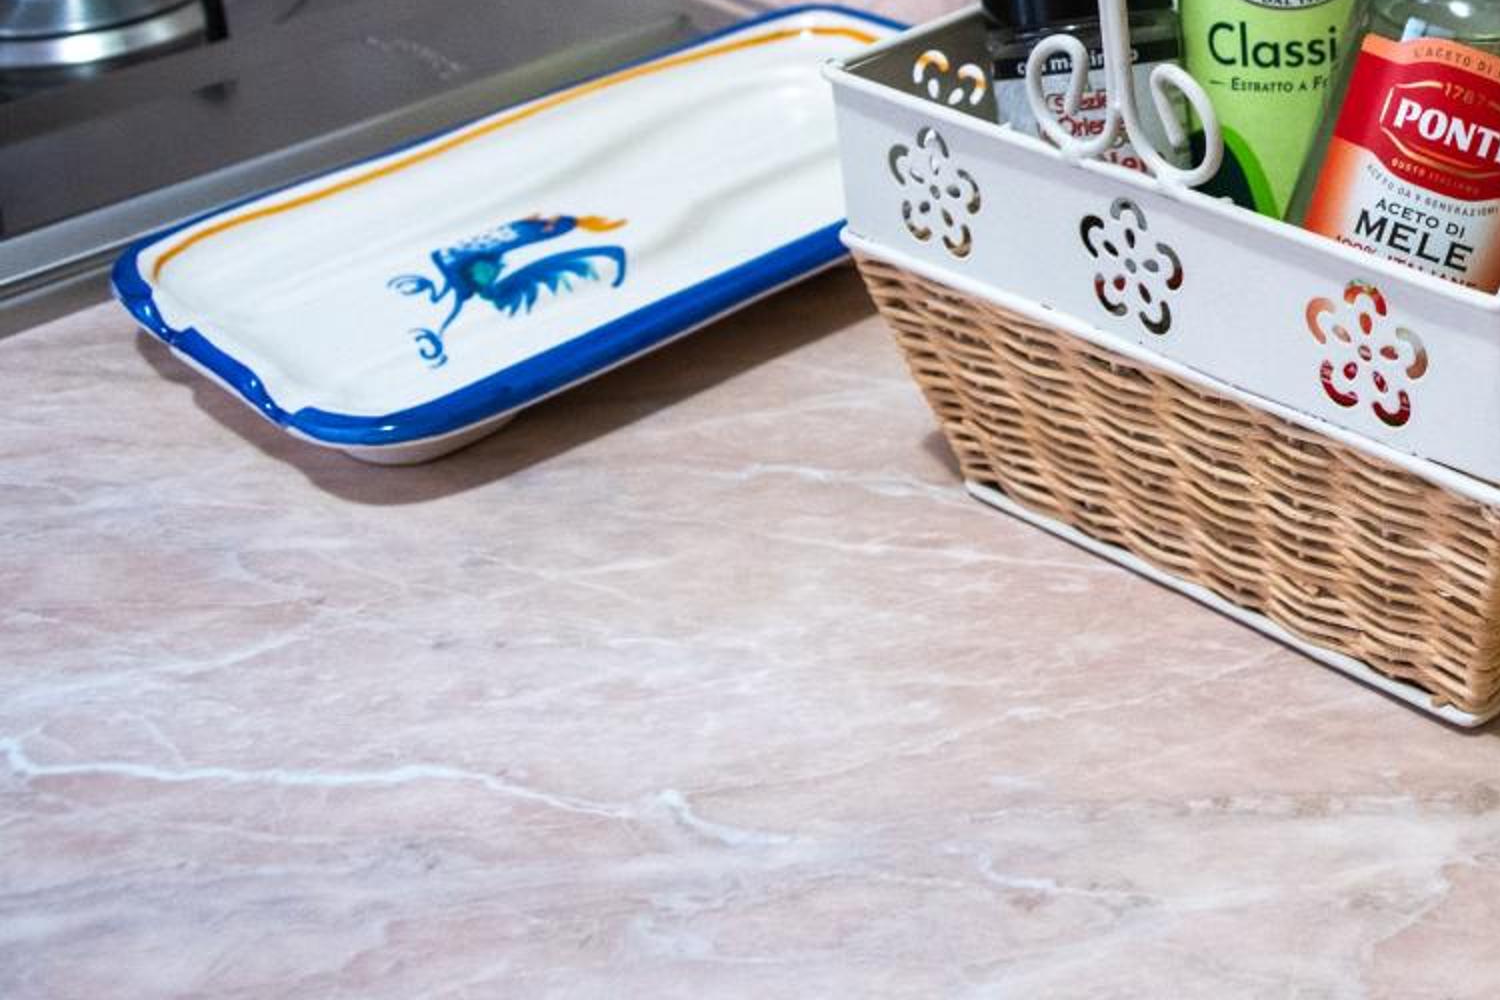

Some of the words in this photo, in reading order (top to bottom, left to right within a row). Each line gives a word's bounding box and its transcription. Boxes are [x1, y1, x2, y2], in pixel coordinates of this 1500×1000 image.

[1477, 60, 1493, 75] DI
[1375, 197, 1440, 230] ACETO
[1444, 221, 1466, 239] DI
[1354, 207, 1474, 273] MELE
